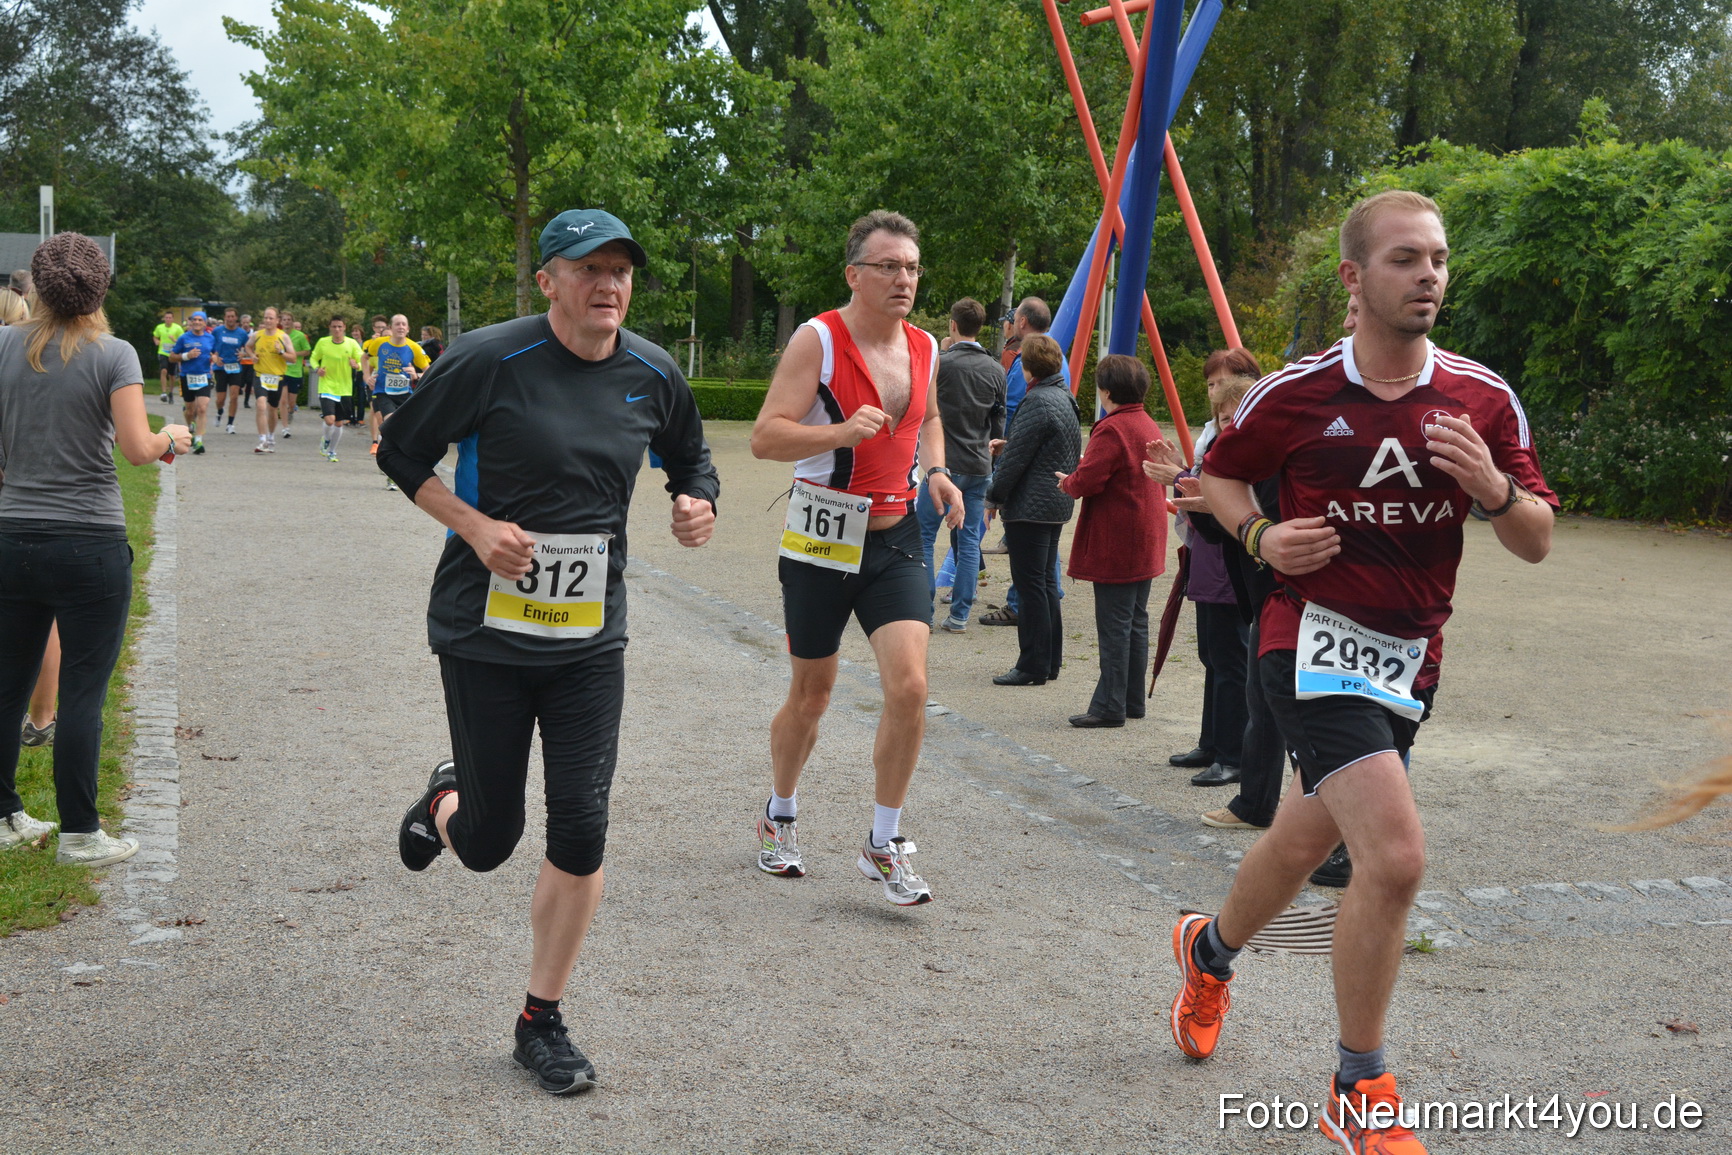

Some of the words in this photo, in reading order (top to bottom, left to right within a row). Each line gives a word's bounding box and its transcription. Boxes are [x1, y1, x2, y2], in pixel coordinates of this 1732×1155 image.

[388, 378, 408, 387] 2820
[1323, 427, 1354, 437] adidas
[814, 494, 854, 511] Neumarkt
[1326, 500, 1454, 525] AREVA
[802, 504, 847, 541] 161
[541, 543, 594, 555] Neumarkt
[804, 541, 831, 556] Gerd
[516, 557, 589, 598] 312
[523, 603, 569, 623] Enrico
[1305, 611, 1346, 630] PARTL
[1348, 625, 1404, 654] Nmarkt
[1311, 630, 1406, 695] 2932
